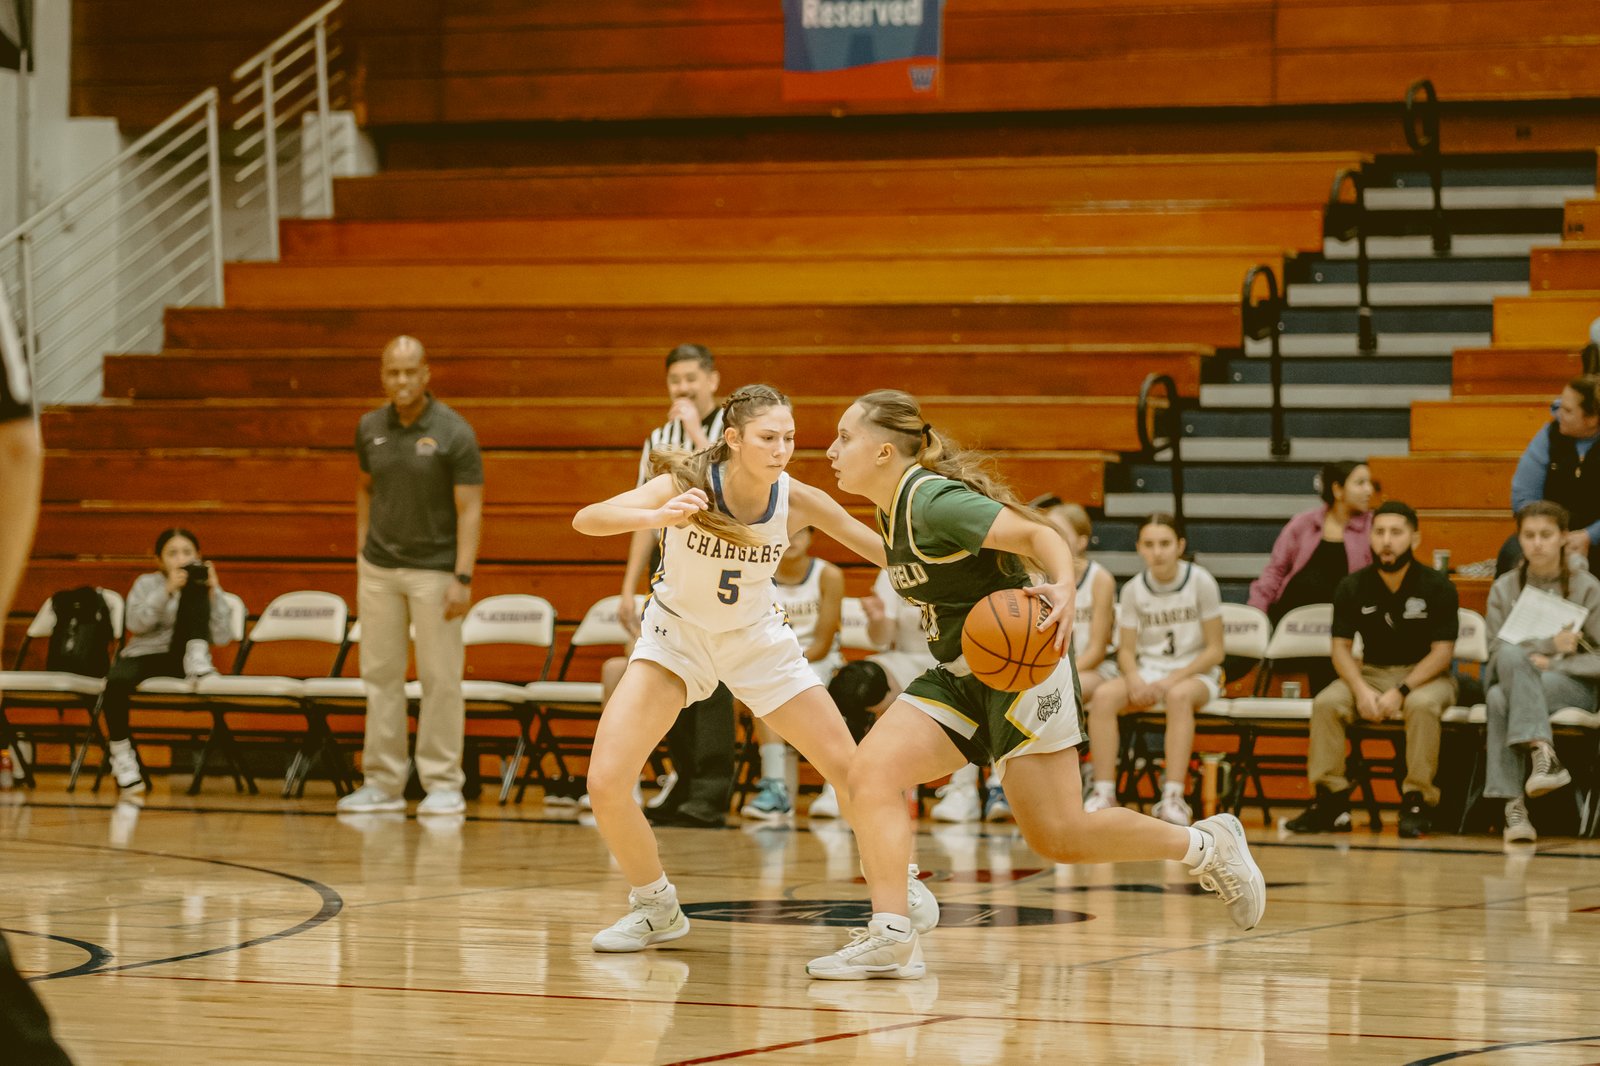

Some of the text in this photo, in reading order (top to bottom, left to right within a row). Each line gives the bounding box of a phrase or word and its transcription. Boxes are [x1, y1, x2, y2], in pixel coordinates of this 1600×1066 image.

[801, 0, 923, 28] Reserved
[717, 569, 742, 605] 5
[1163, 630, 1175, 656] 3
